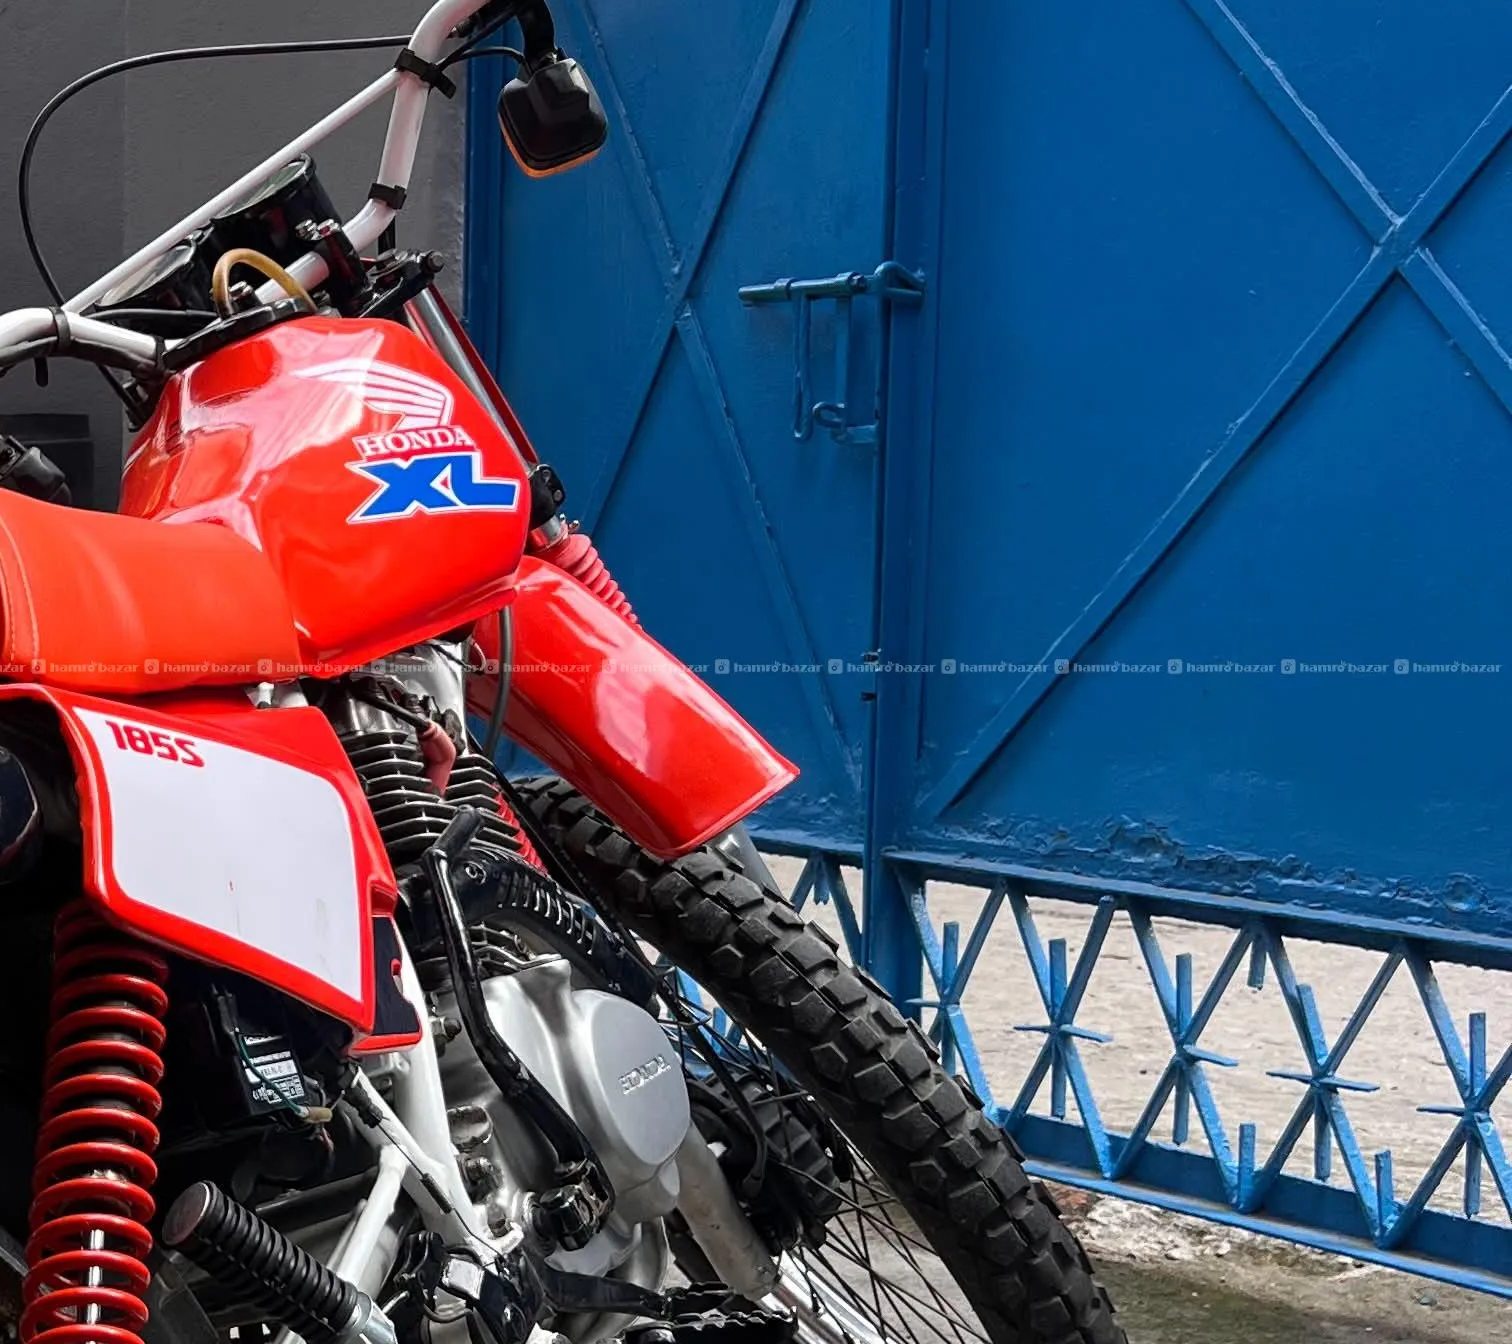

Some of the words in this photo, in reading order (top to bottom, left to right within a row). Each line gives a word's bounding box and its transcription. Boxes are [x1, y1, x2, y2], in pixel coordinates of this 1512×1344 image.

[356, 426, 475, 457] HONDA
[347, 453, 519, 523] XL
[105, 719, 205, 768] 185S
